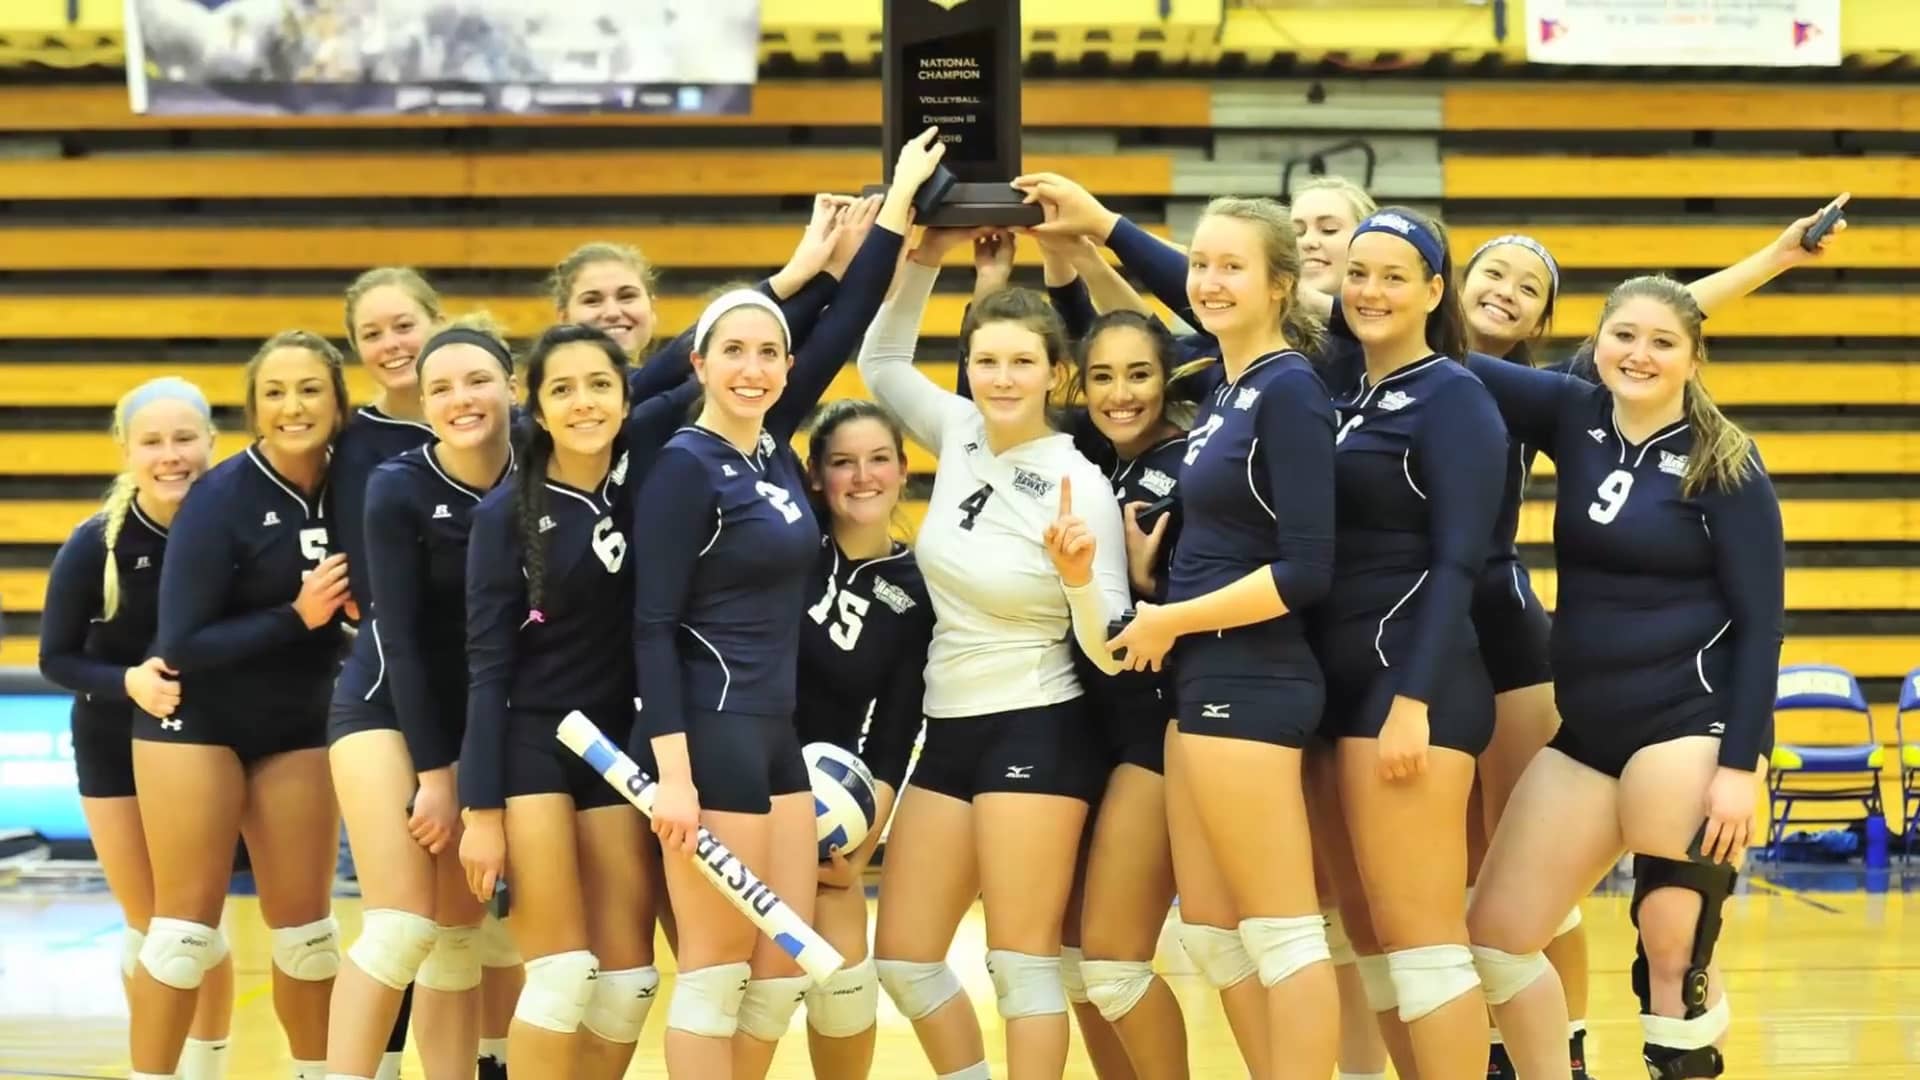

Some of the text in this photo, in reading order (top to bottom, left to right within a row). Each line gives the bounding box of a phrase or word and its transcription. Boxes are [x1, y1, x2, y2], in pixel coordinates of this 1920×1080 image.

[918, 70, 980, 80] CHAMPION
[919, 58, 979, 68] NATIONAL
[919, 95, 980, 104] VOLLEYBALL
[755, 480, 803, 524] 2
[1013, 468, 1050, 497] HAWKS
[1588, 469, 1635, 525] 9
[958, 483, 994, 531] 4
[592, 516, 627, 573] 6
[808, 574, 871, 651] 15
